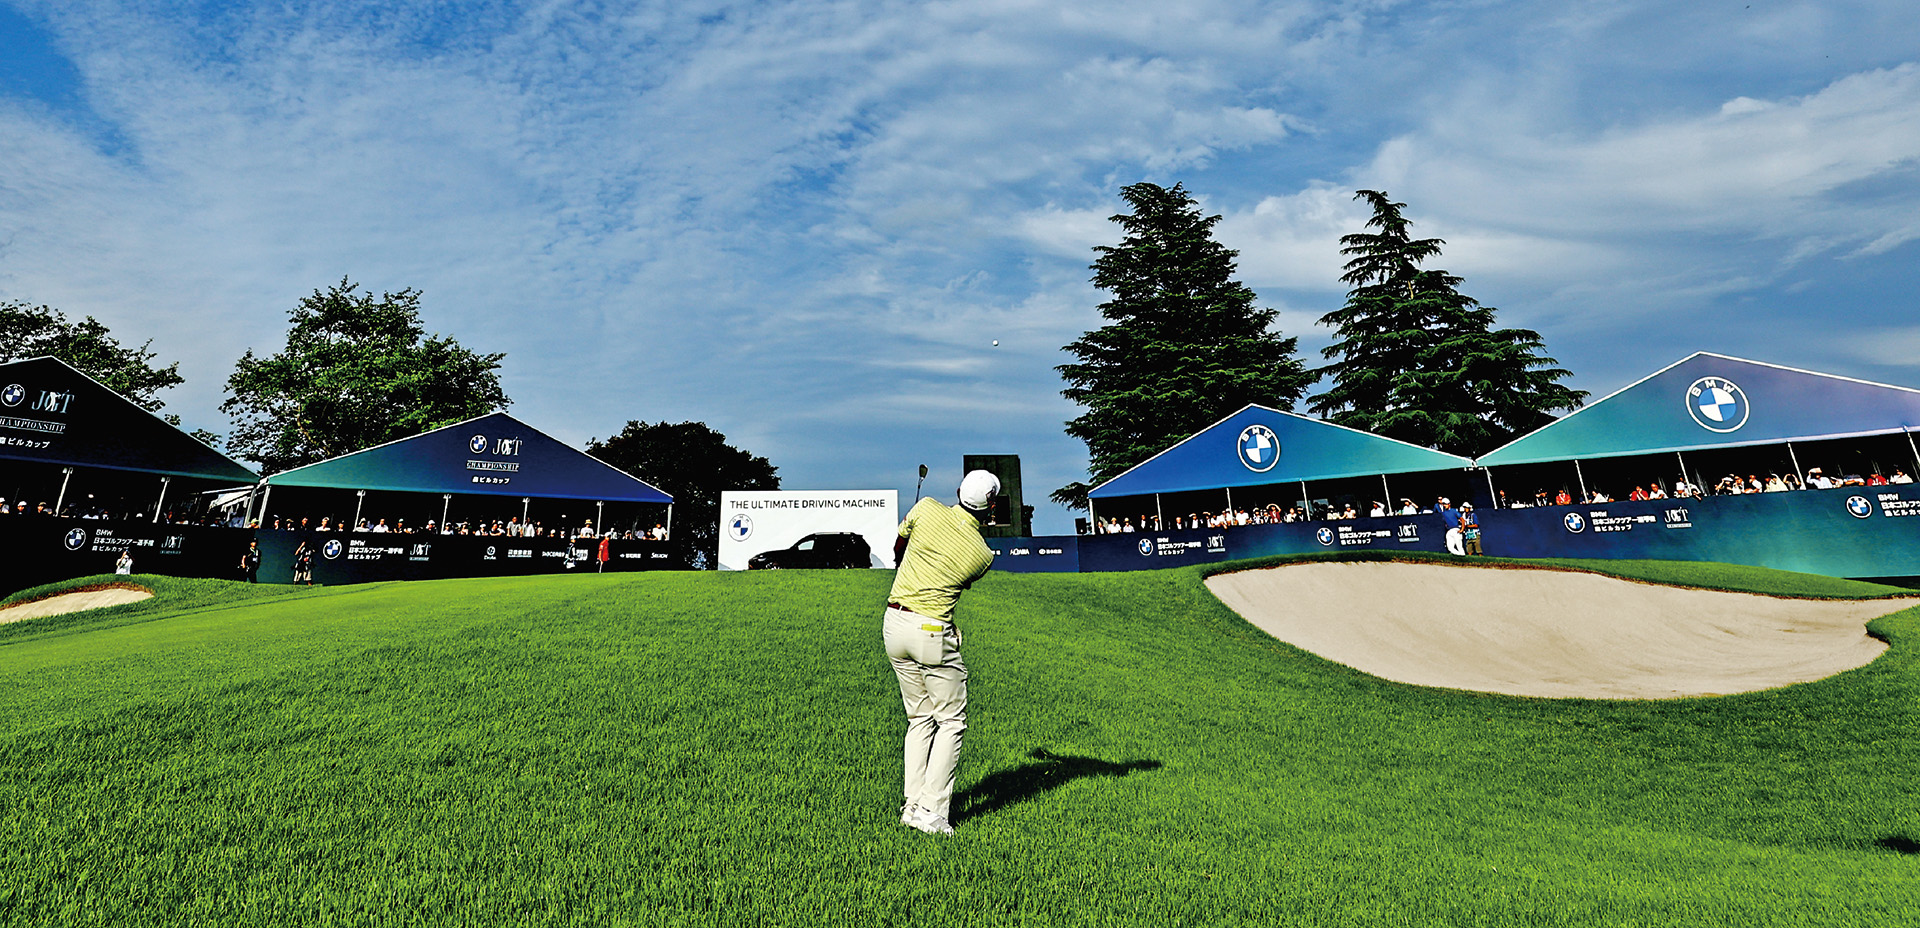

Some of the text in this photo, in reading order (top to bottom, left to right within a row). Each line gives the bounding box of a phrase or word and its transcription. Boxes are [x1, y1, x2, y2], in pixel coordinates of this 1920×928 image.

[0, 418, 66, 432] HAMPIONSHIP
[1877, 493, 1899, 501] BMW
[730, 499, 885, 509] THE ULTIMATE DRIVING MACHINE
